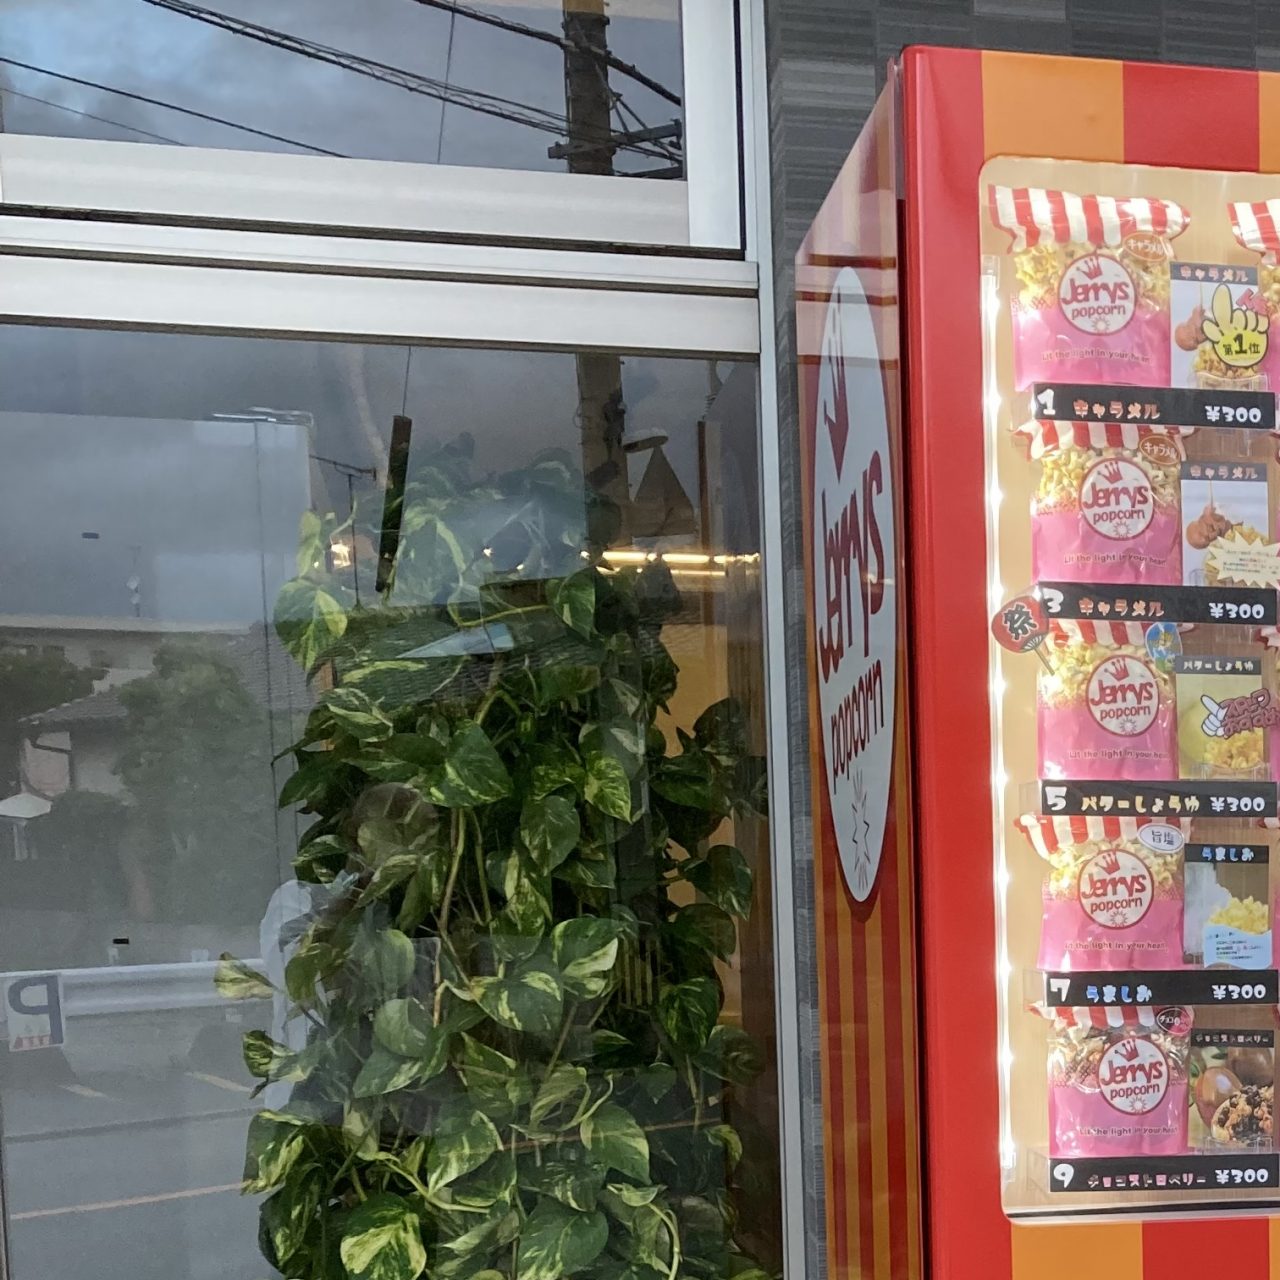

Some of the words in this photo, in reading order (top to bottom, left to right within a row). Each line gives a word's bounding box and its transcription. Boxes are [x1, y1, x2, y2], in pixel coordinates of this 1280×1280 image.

[1180, 266, 1248, 282] キャラメル
[1072, 304, 1126, 320] popcorn
[1223, 333, 1260, 356] 第1位
[1037, 388, 1056, 416] 1
[1073, 400, 1160, 420] キャラメル
[1190, 465, 1258, 480] キャラメル
[1093, 509, 1146, 525] popcorn
[1043, 589, 1064, 613] 3
[1079, 598, 1164, 616] キャラメル
[1003, 604, 1039, 640] 祭
[1183, 660, 1254, 671] バターしょうゆ
[1100, 706, 1151, 720] popcorn
[831, 658, 884, 793] popcorn
[1044, 786, 1068, 810] 5
[1081, 796, 1200, 814] バターしょうゆ
[1202, 847, 1254, 861] うましお
[1090, 897, 1142, 914] popcorn
[1050, 978, 1070, 1002] 7
[1086, 985, 1152, 1003] うましお
[1110, 1084, 1160, 1101] popcorn
[1053, 1163, 1074, 1189] 9
